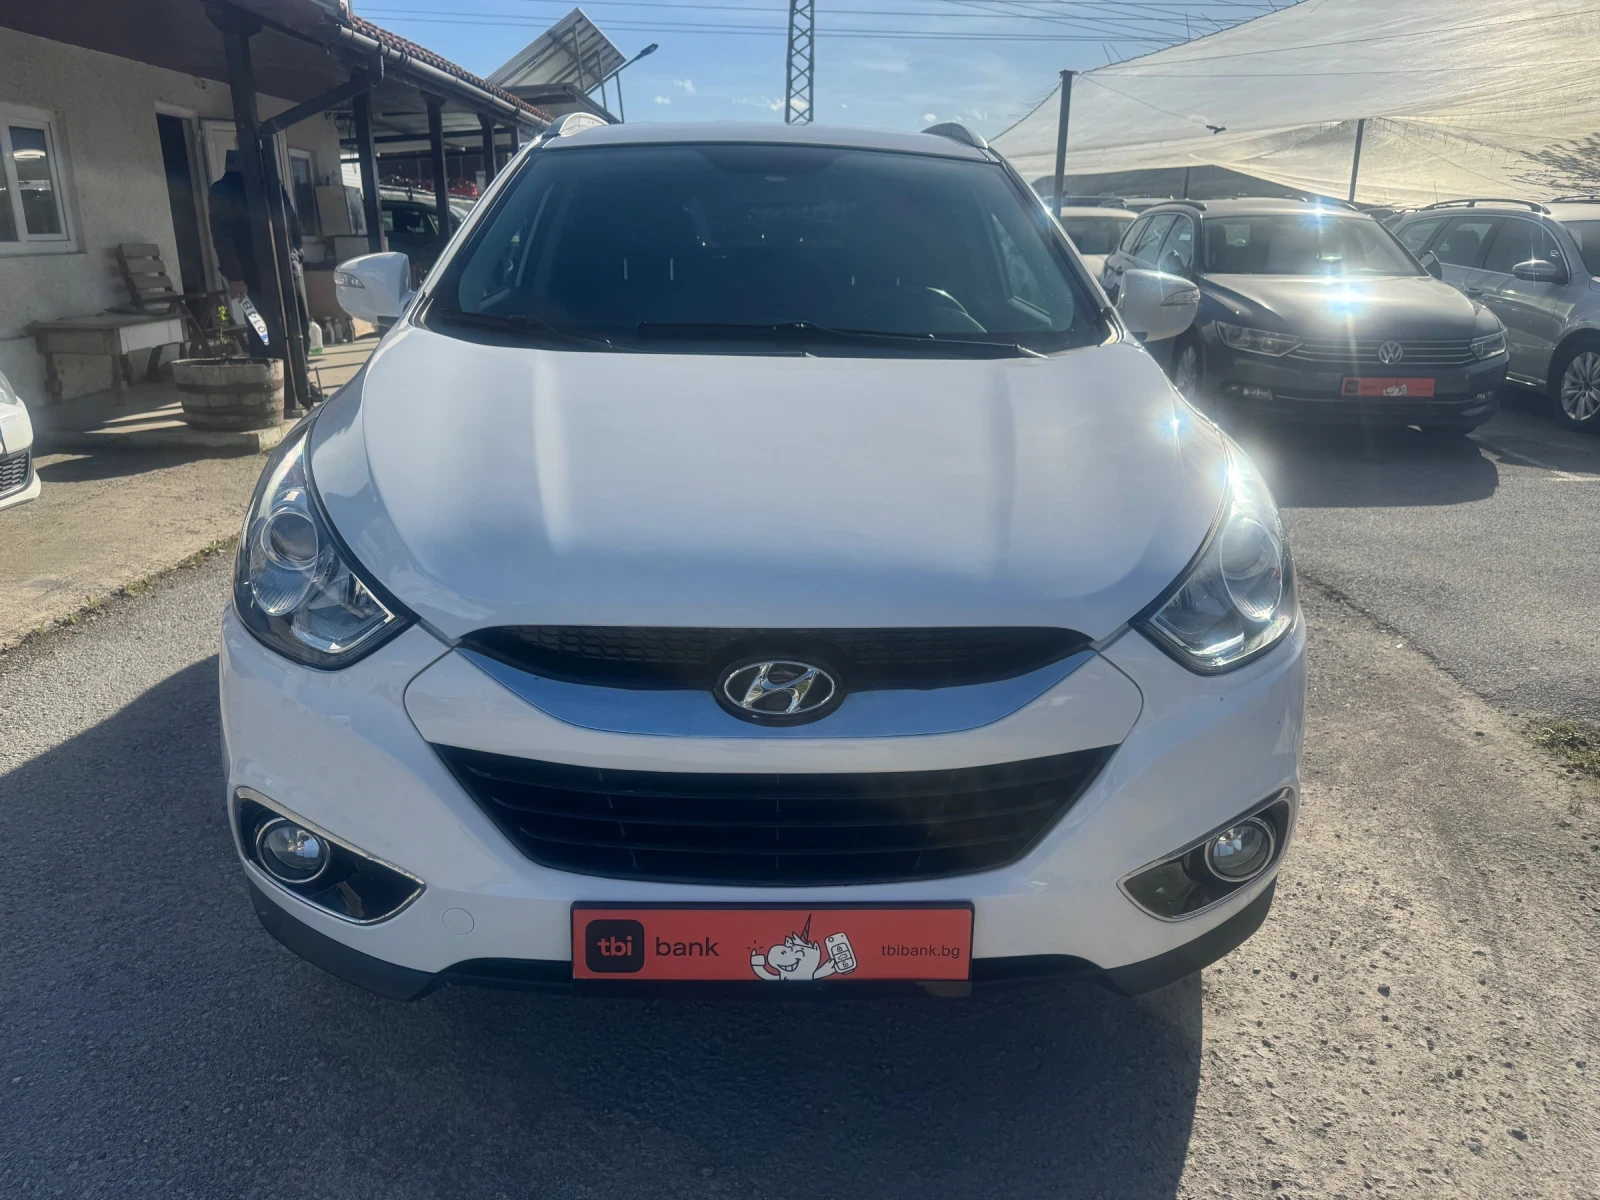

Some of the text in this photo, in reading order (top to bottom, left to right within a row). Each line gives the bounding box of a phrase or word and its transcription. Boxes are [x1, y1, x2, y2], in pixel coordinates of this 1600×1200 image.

[597, 936, 960, 959] tbi bank tbibank.bg
